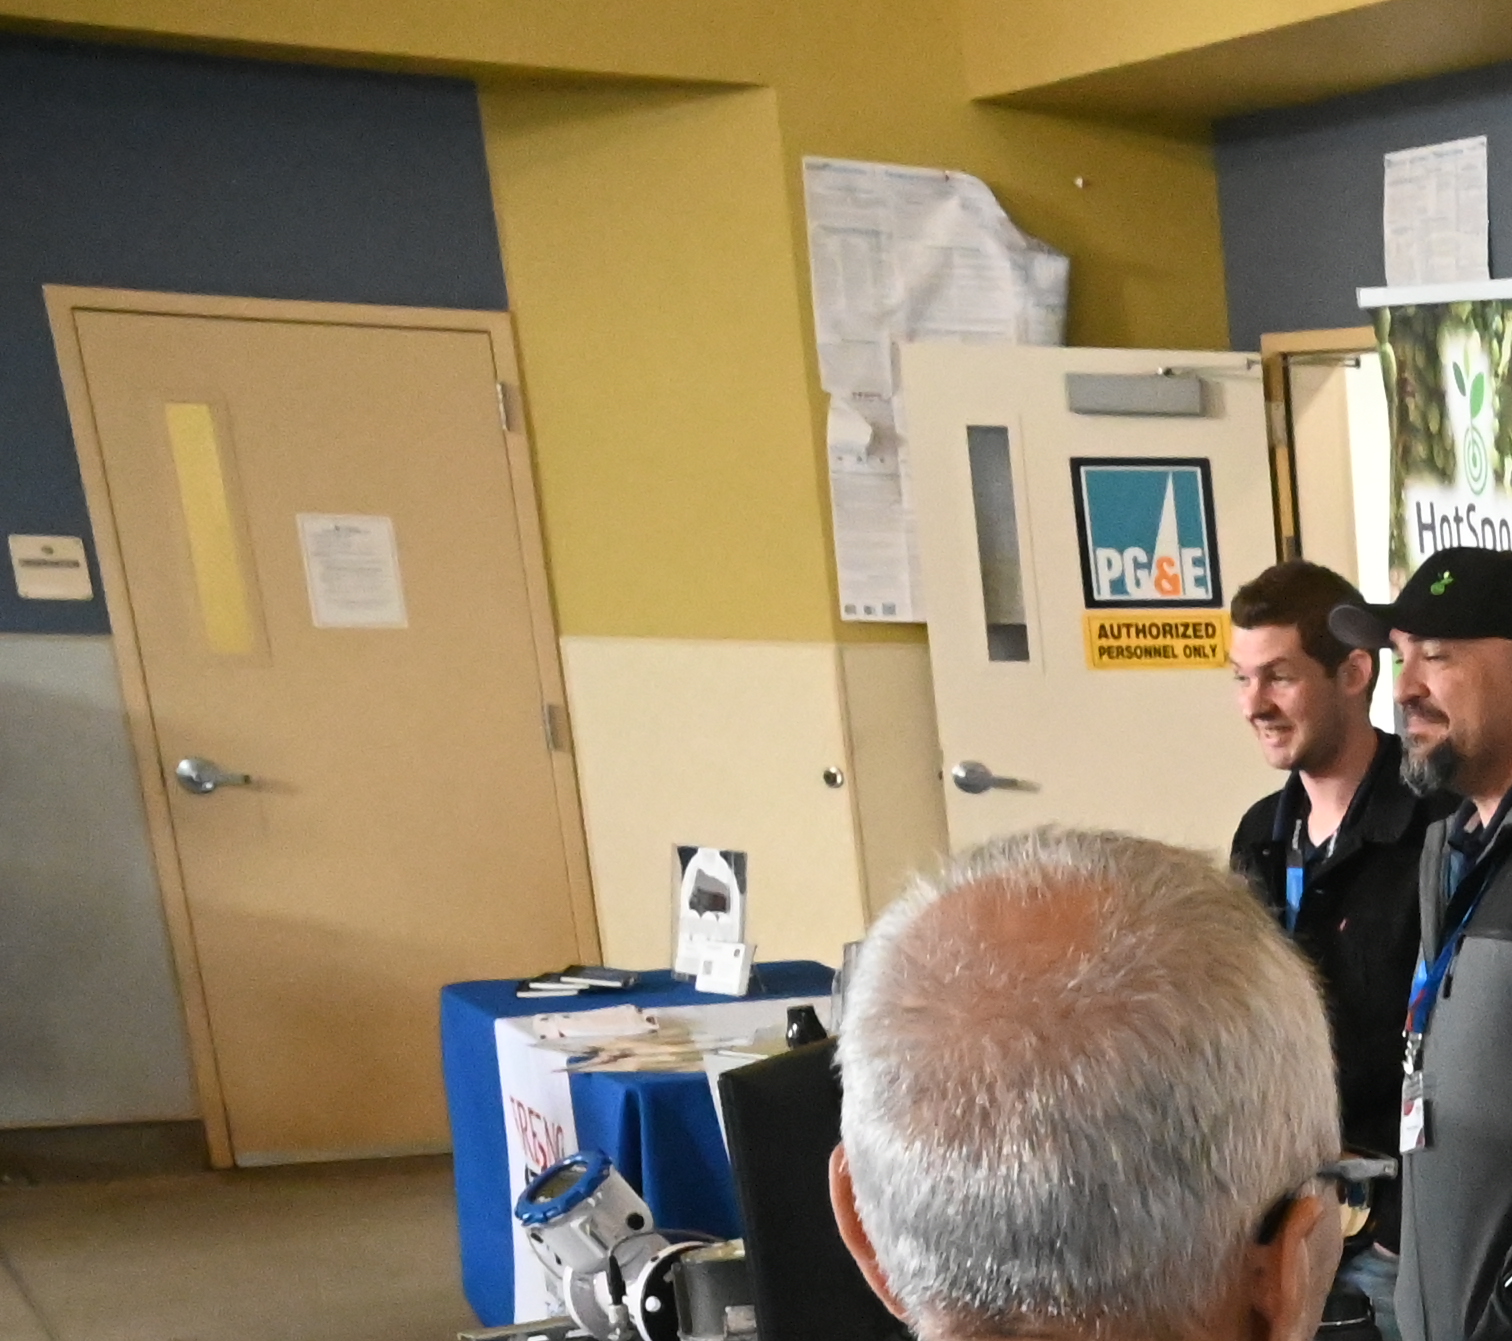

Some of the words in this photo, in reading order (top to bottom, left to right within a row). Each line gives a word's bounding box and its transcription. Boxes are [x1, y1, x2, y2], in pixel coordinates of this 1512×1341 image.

[1094, 546, 1208, 598] PG&E
[1097, 622, 1217, 641] AUTHORIZED
[1098, 643, 1179, 661] PERSONNEL
[1183, 643, 1218, 659] ONLY
